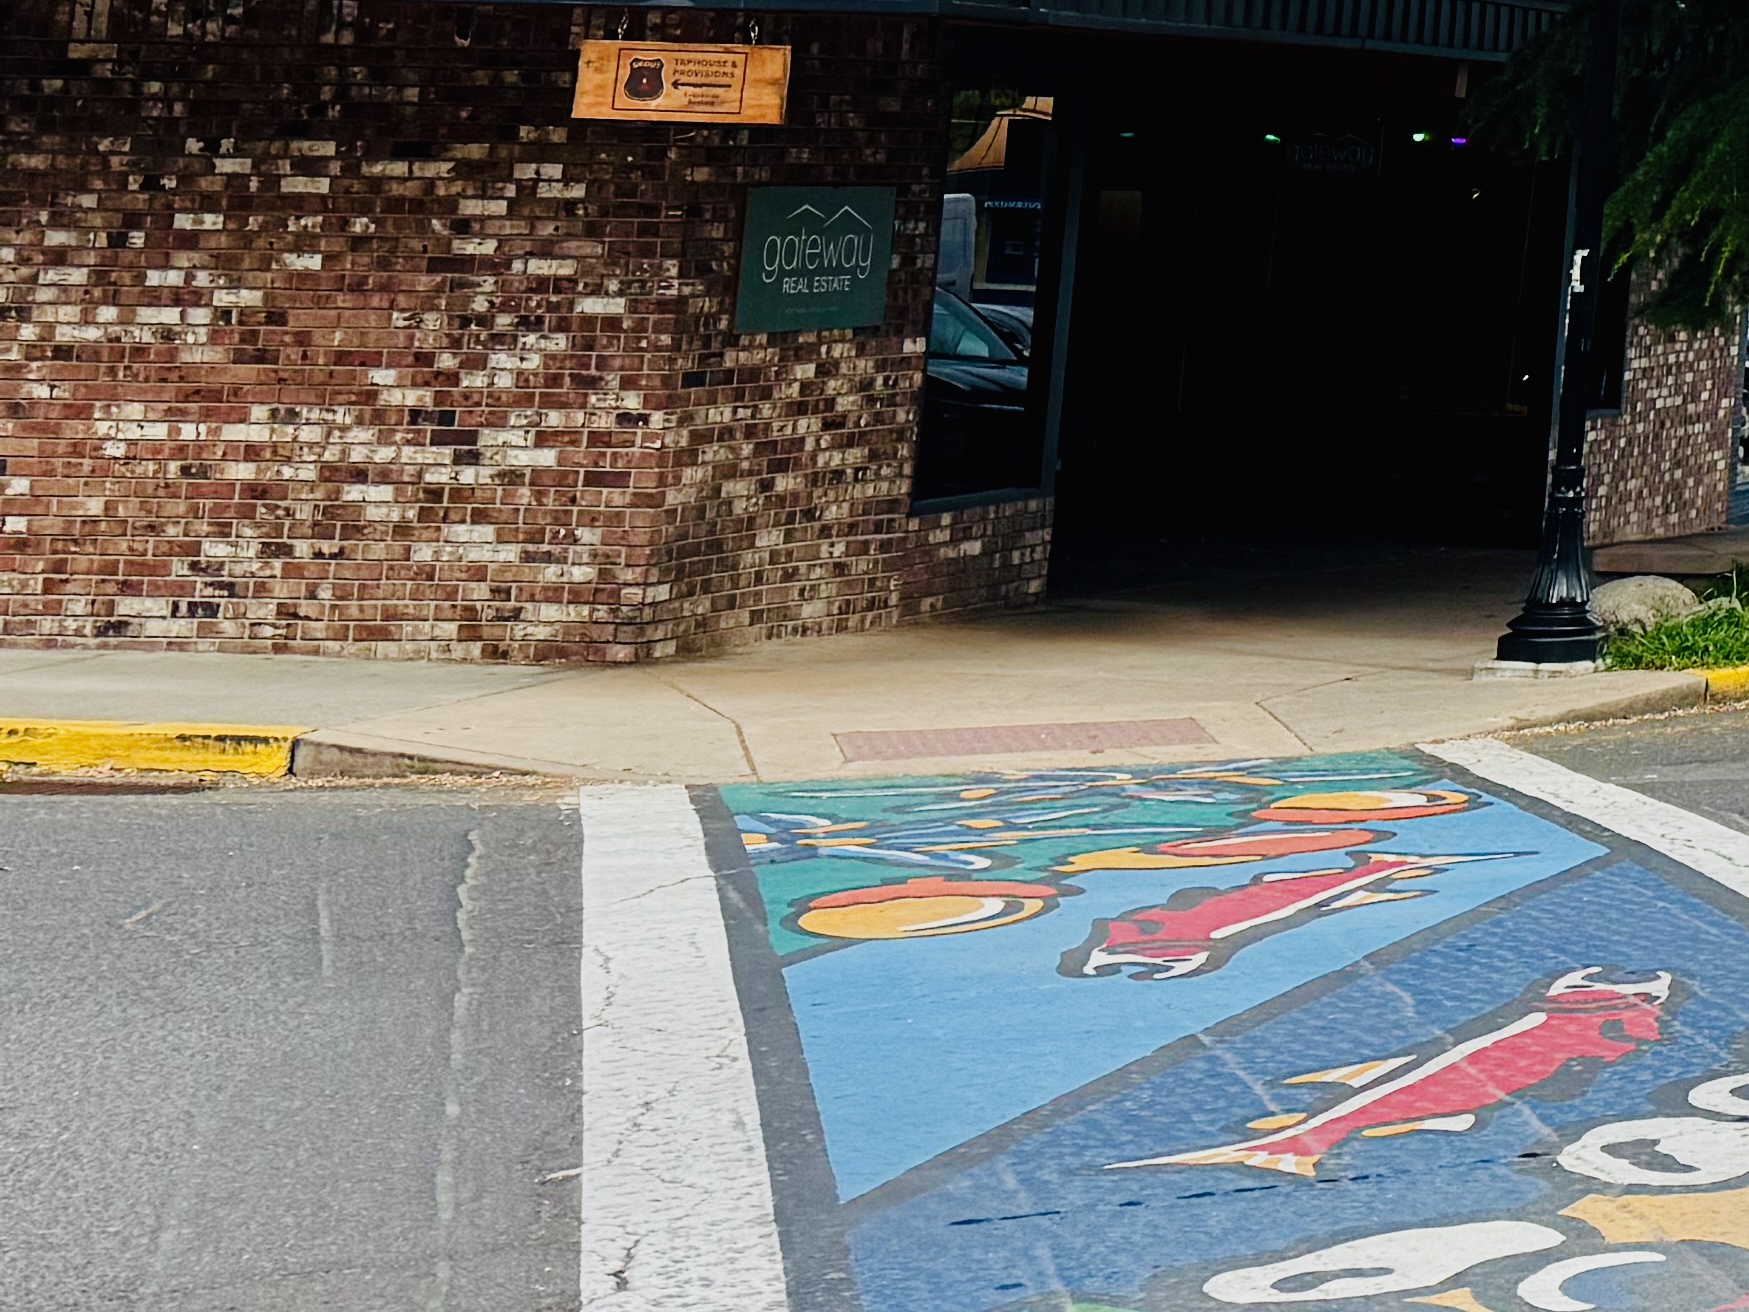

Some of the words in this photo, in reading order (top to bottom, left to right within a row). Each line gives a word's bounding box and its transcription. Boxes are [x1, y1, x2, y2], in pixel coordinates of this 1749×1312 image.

[673, 58, 729, 67] TAPHOUSE
[672, 68, 735, 78] PROVISIONS
[762, 227, 874, 283] gateway
[782, 277, 809, 294] REAL
[813, 275, 851, 293] ESTATE
